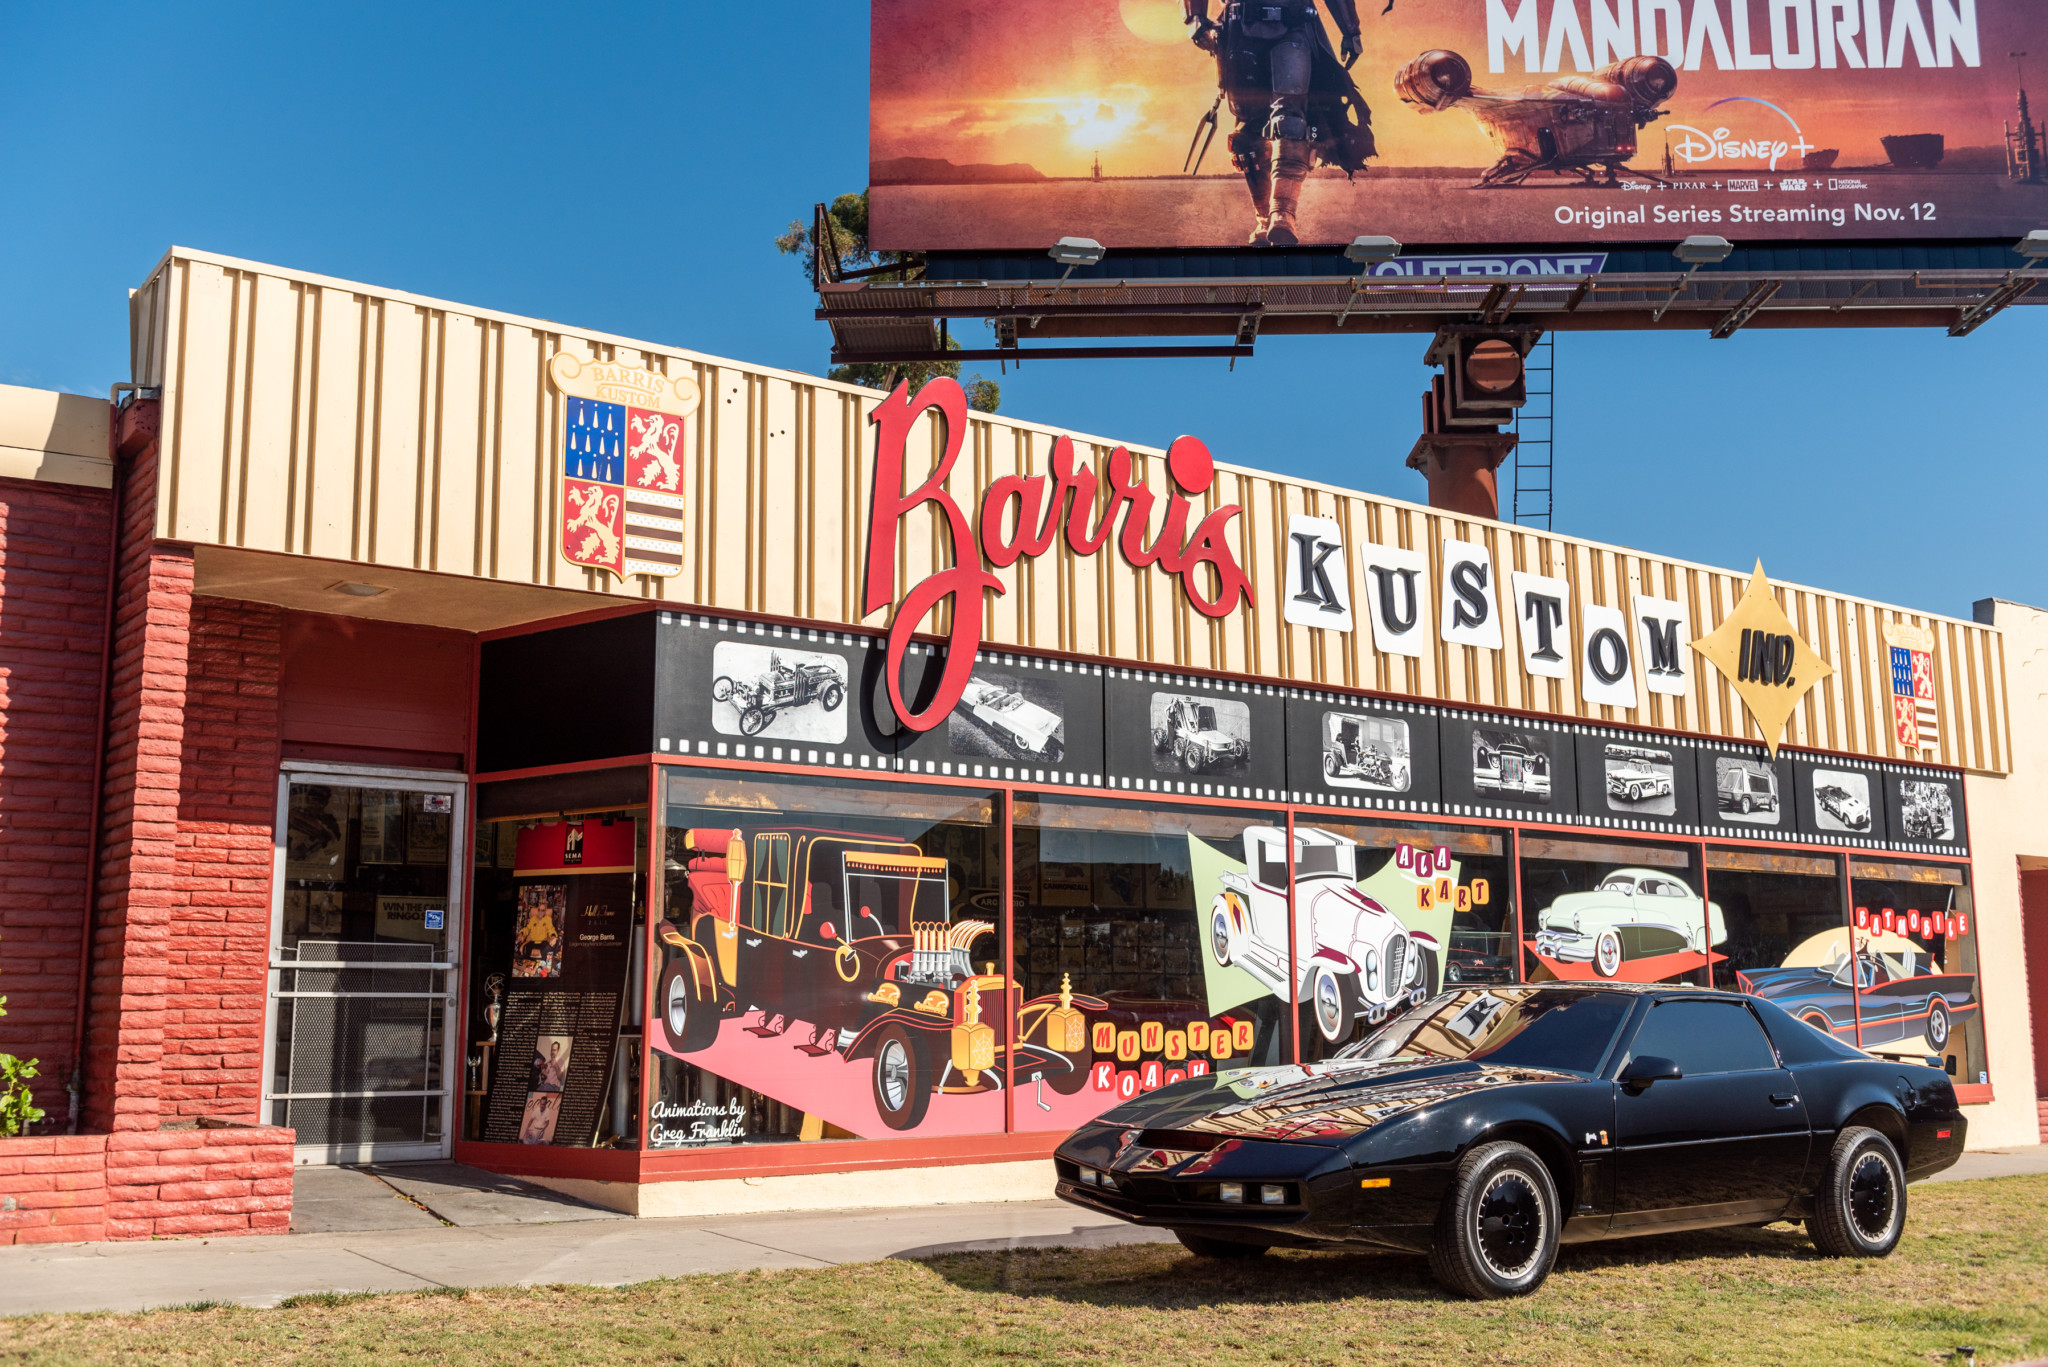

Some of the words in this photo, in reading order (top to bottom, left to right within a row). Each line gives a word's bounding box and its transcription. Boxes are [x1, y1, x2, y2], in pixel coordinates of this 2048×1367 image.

[1487, 0, 1981, 73] MANDALORIAN
[1673, 182, 1707, 190] PIXAR
[1728, 180, 1758, 191] MARVEL
[1554, 204, 1645, 229] Original
[1653, 204, 1722, 223] Series
[1729, 204, 1845, 227] Streaming
[1853, 203, 1906, 221] Nov.
[1909, 203, 1936, 220] 12
[592, 367, 665, 393] BARRIS
[596, 385, 661, 409] KUSTOM
[862, 376, 1254, 732] Barris
[1291, 532, 1685, 686] KUSTOM
[1738, 628, 1797, 687] IND.
[564, 852, 582, 860] SEMA
[383, 902, 404, 911] WIN
[406, 903, 422, 911] THE
[1421, 880, 1485, 908] KART
[387, 912, 420, 921] RINGO
[1858, 910, 1966, 938] BATMOBILE
[579, 933, 599, 942] George
[600, 933, 615, 941] Barris
[1095, 1025, 1249, 1057] MUNSTER
[651, 1099, 727, 1119] Animations
[729, 1097, 746, 1123] by
[650, 1123, 686, 1147] Greg
[689, 1119, 746, 1140] Franklin
